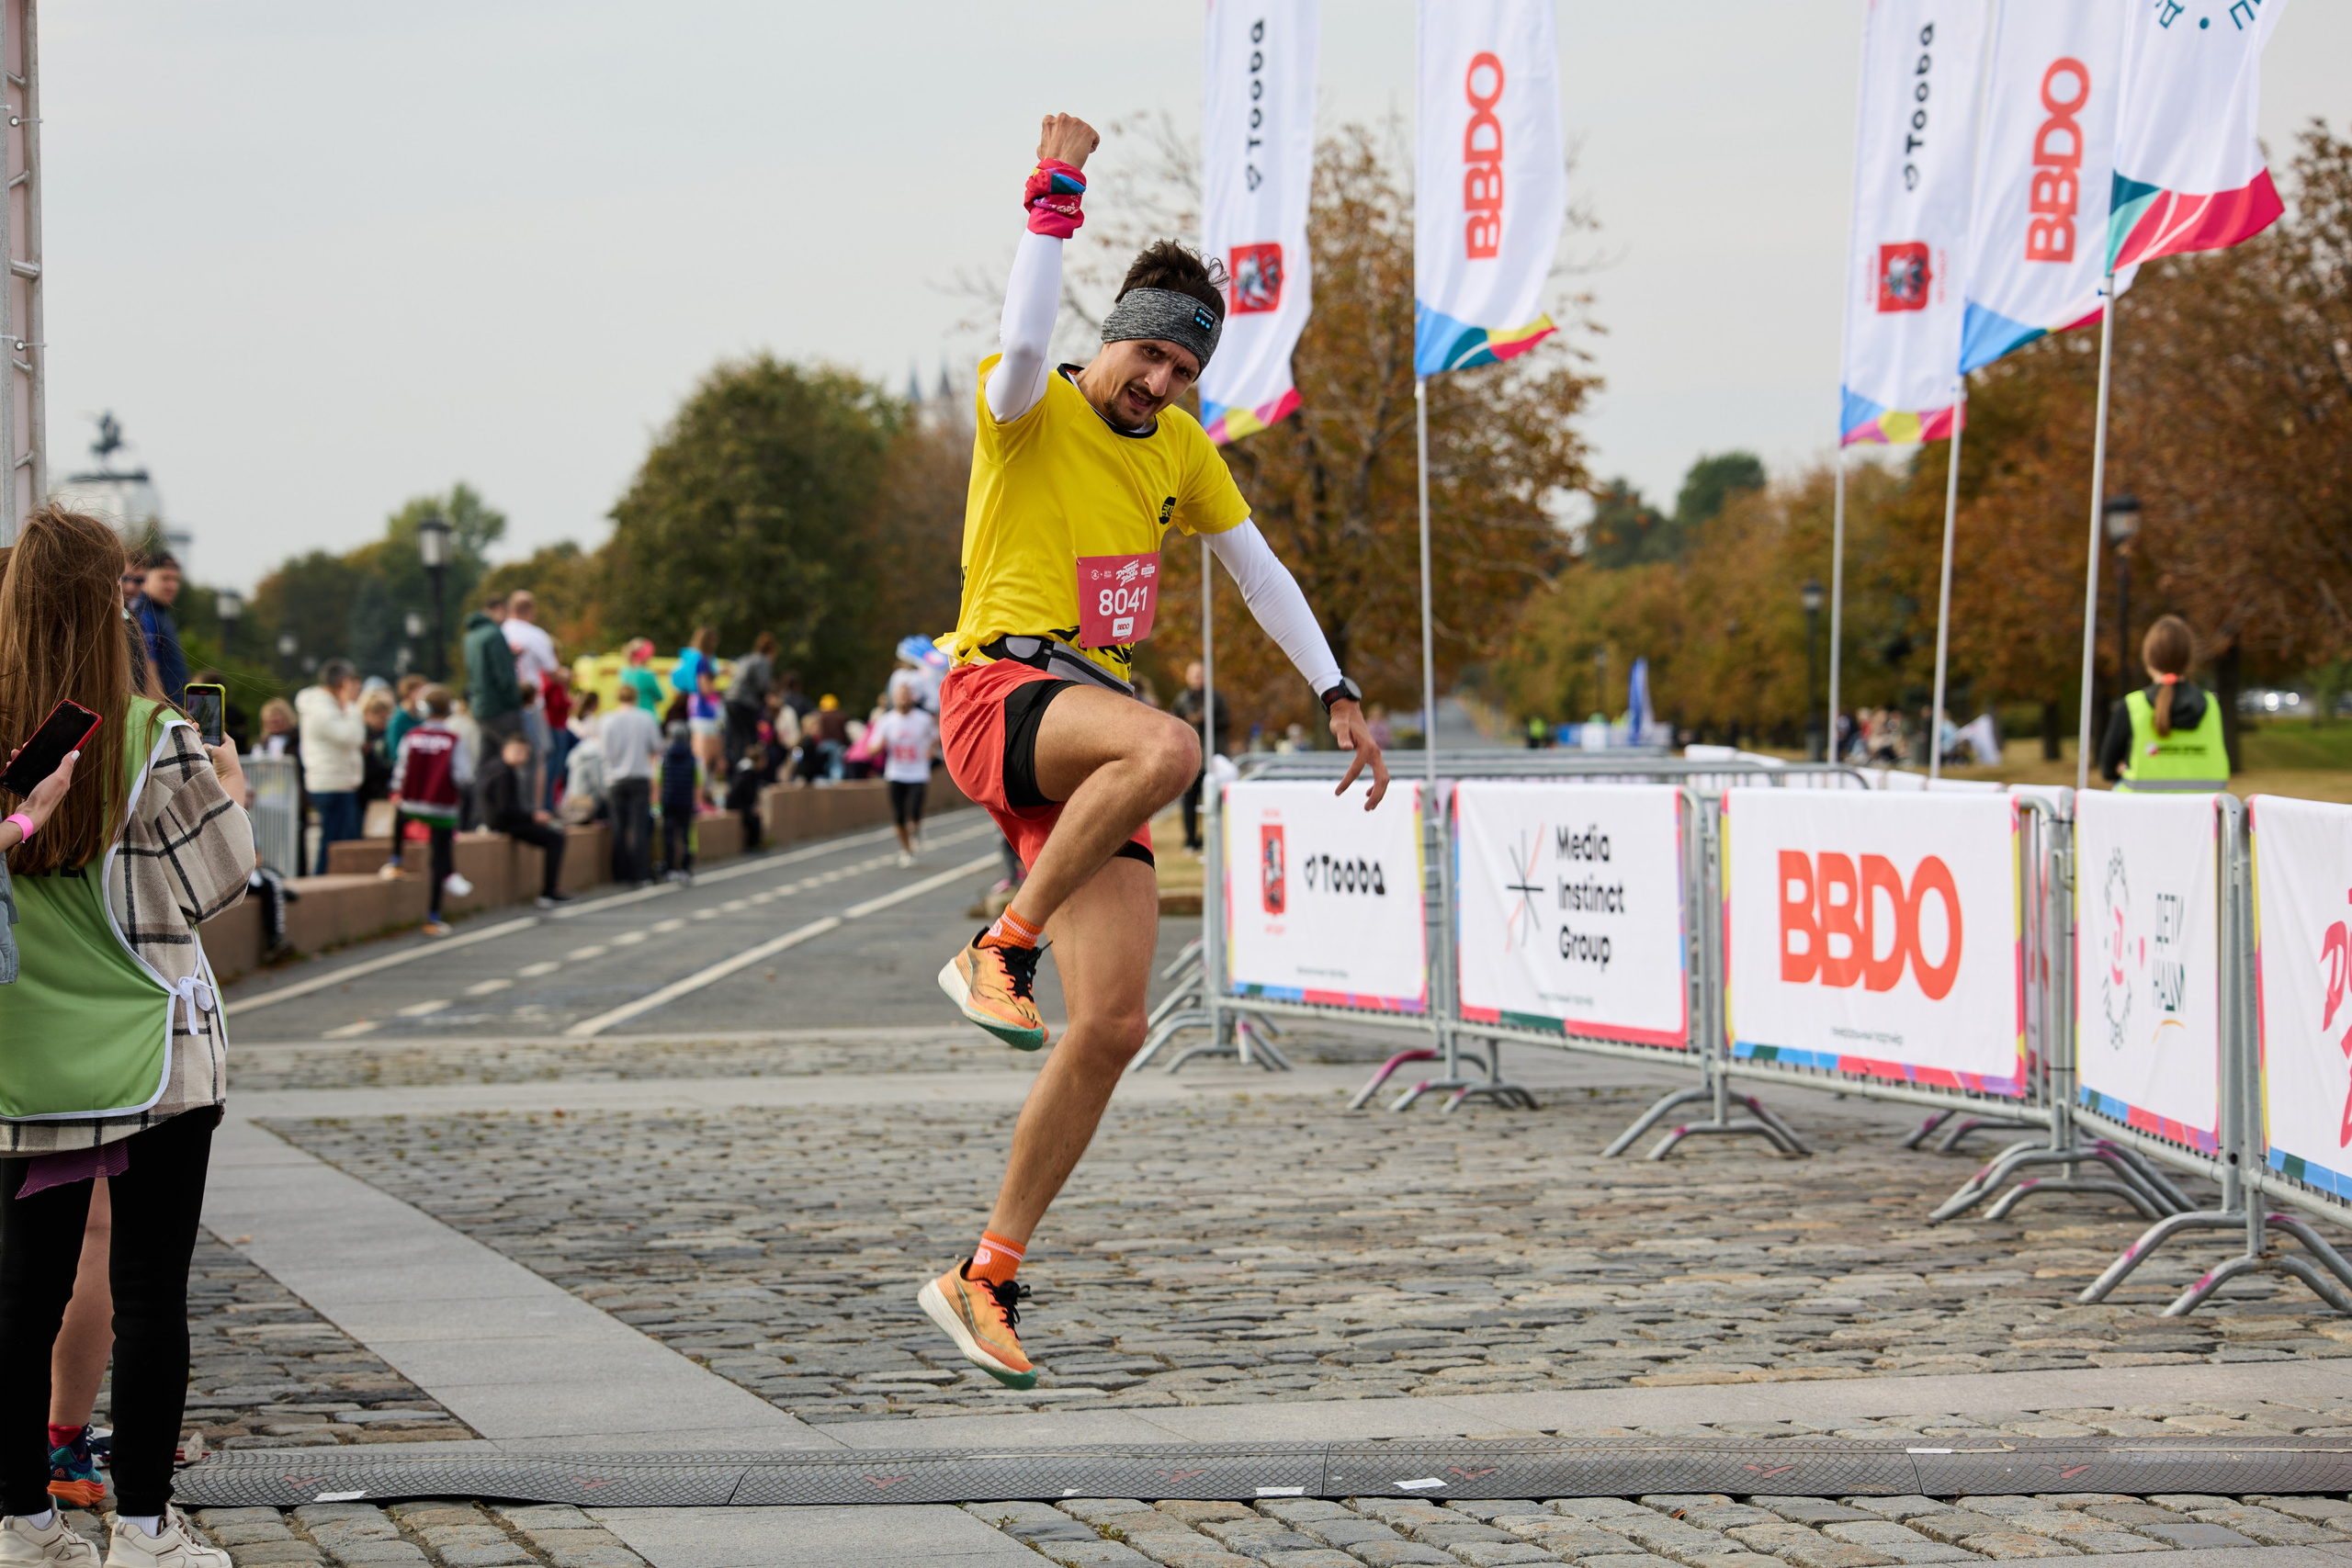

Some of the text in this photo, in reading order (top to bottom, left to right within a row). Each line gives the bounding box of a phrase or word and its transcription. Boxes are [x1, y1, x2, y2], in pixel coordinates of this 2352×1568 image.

[1463, 51, 1506, 261] BBDO
[2024, 56, 2091, 264] BBDO
[1098, 585, 1148, 616] 8041
[1117, 623, 1130, 631] BBDO
[1555, 824, 1611, 863] Media
[1321, 854, 1386, 897] Tooba
[1558, 874, 1624, 915] Instinct
[1777, 849, 1964, 1002] BBDO
[2154, 893, 2185, 953] ДЕТИ
[1558, 924, 1611, 972] Group
